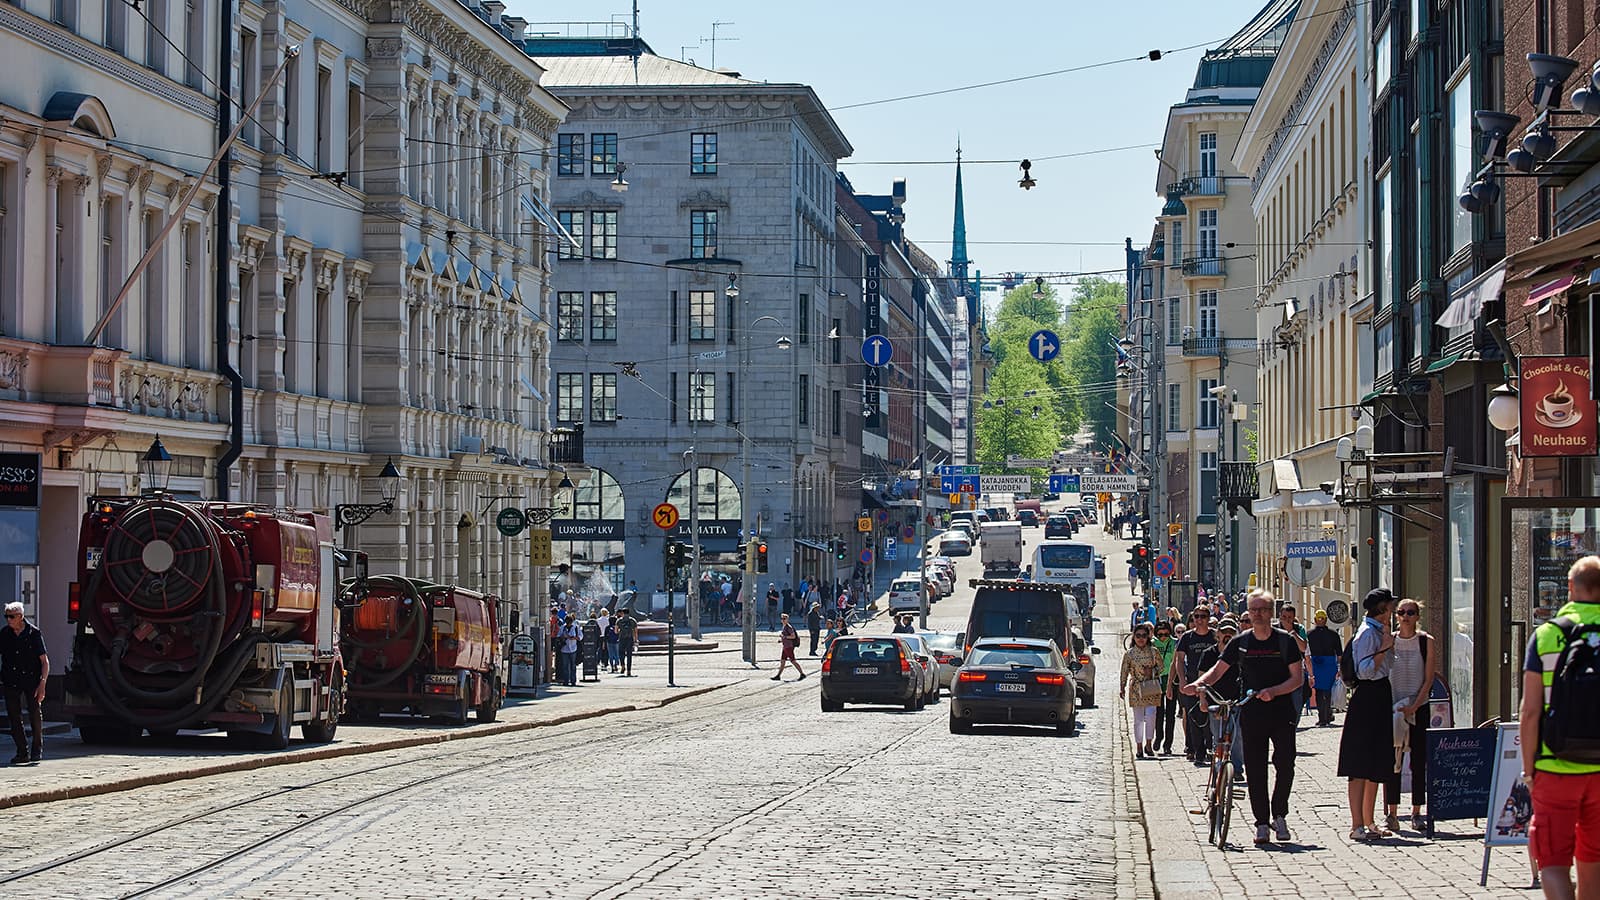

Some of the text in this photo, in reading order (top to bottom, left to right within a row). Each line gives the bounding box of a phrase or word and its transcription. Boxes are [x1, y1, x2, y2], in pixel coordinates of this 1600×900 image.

[868, 267, 877, 329] HOTEL
[1523, 364, 1562, 380] Chocolat
[1564, 364, 1571, 372] &
[1533, 434, 1587, 446] Neuhaus
[598, 526, 614, 534] LKV
[679, 526, 692, 534] LA
[1288, 545, 1335, 555] ARTISAANI
[1437, 736, 1480, 749] Neuhaus
